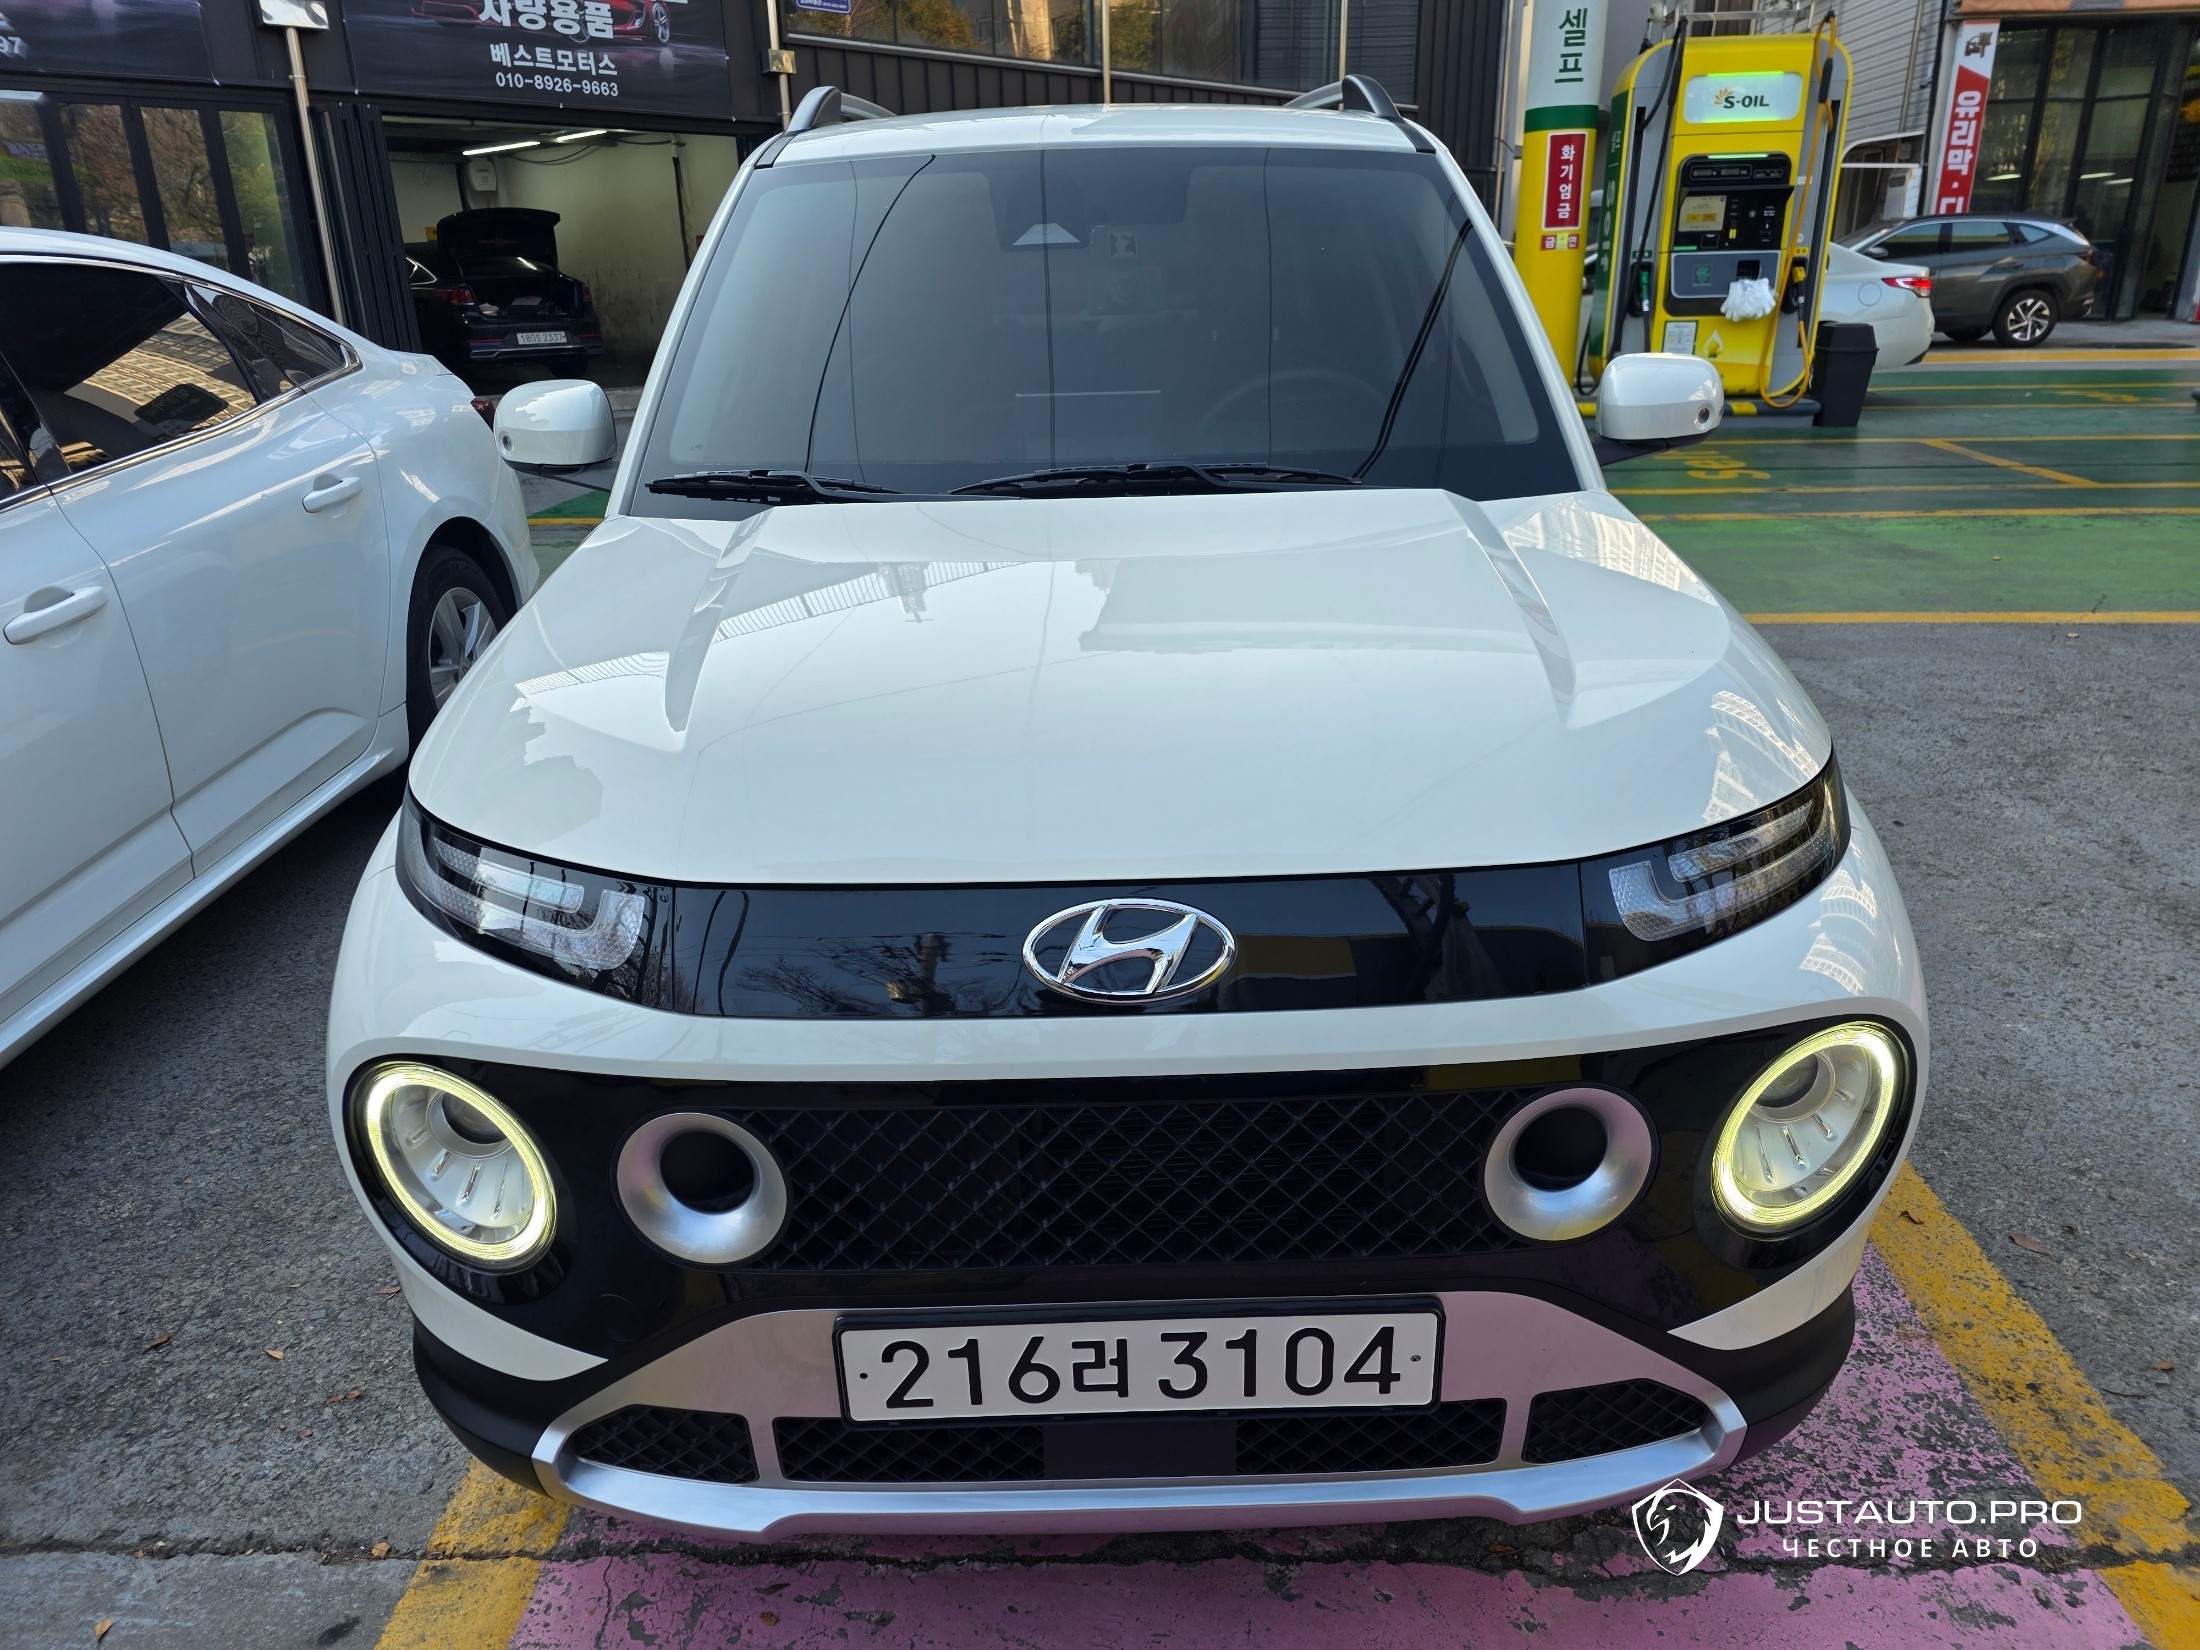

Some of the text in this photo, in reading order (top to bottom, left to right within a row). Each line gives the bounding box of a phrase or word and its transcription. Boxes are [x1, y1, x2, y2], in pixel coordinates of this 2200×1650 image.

[490, 42, 618, 76] 베스트모터스
[1554, 8, 1588, 84] 셀프
[496, 72, 619, 97] 010-8926-9663
[1723, 95, 1770, 109] S-OIL
[1556, 144, 1576, 220] 화기엄금
[881, 1326, 1401, 1409] 216러 3104
